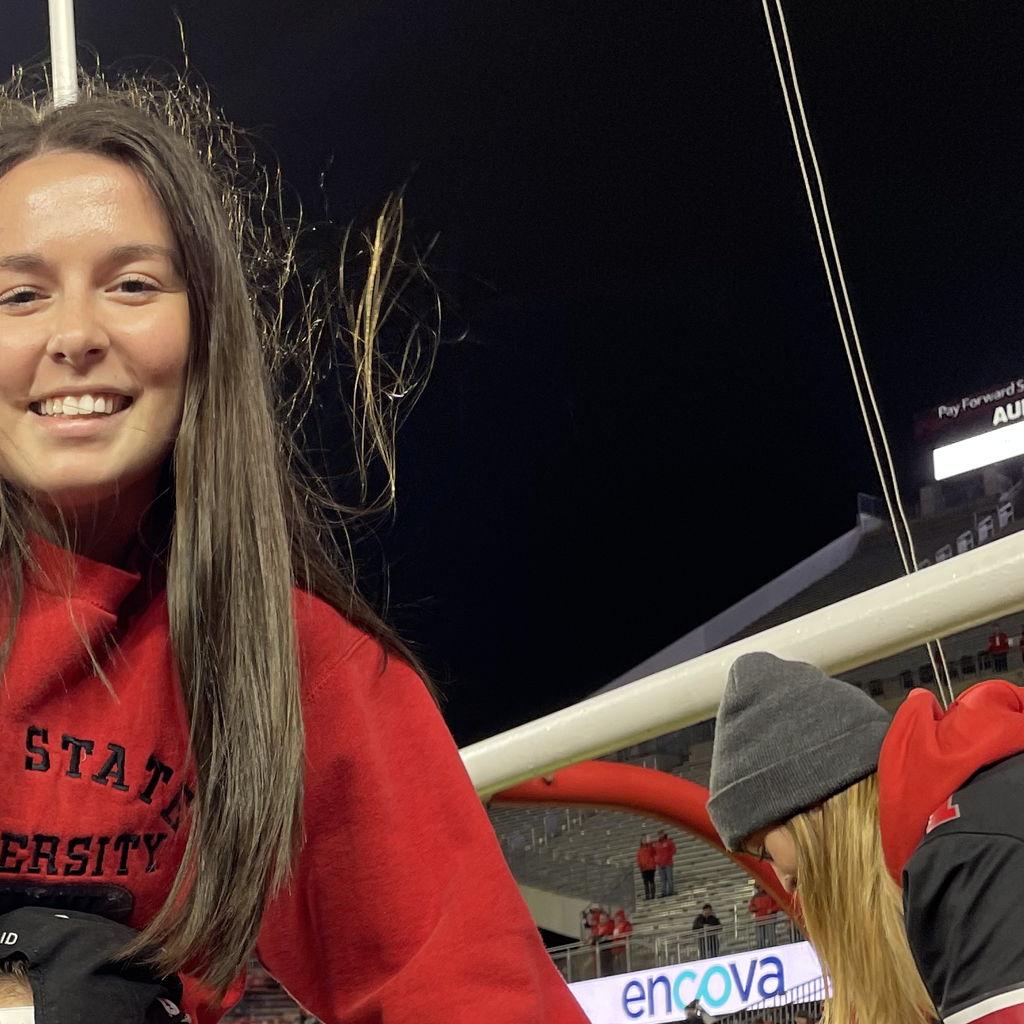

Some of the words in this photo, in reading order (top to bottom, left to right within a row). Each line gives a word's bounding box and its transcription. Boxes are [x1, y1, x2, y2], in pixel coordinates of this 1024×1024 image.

[938, 404, 960, 419] Pay
[961, 382, 1015, 411] Forward
[622, 956, 786, 1018] encova
